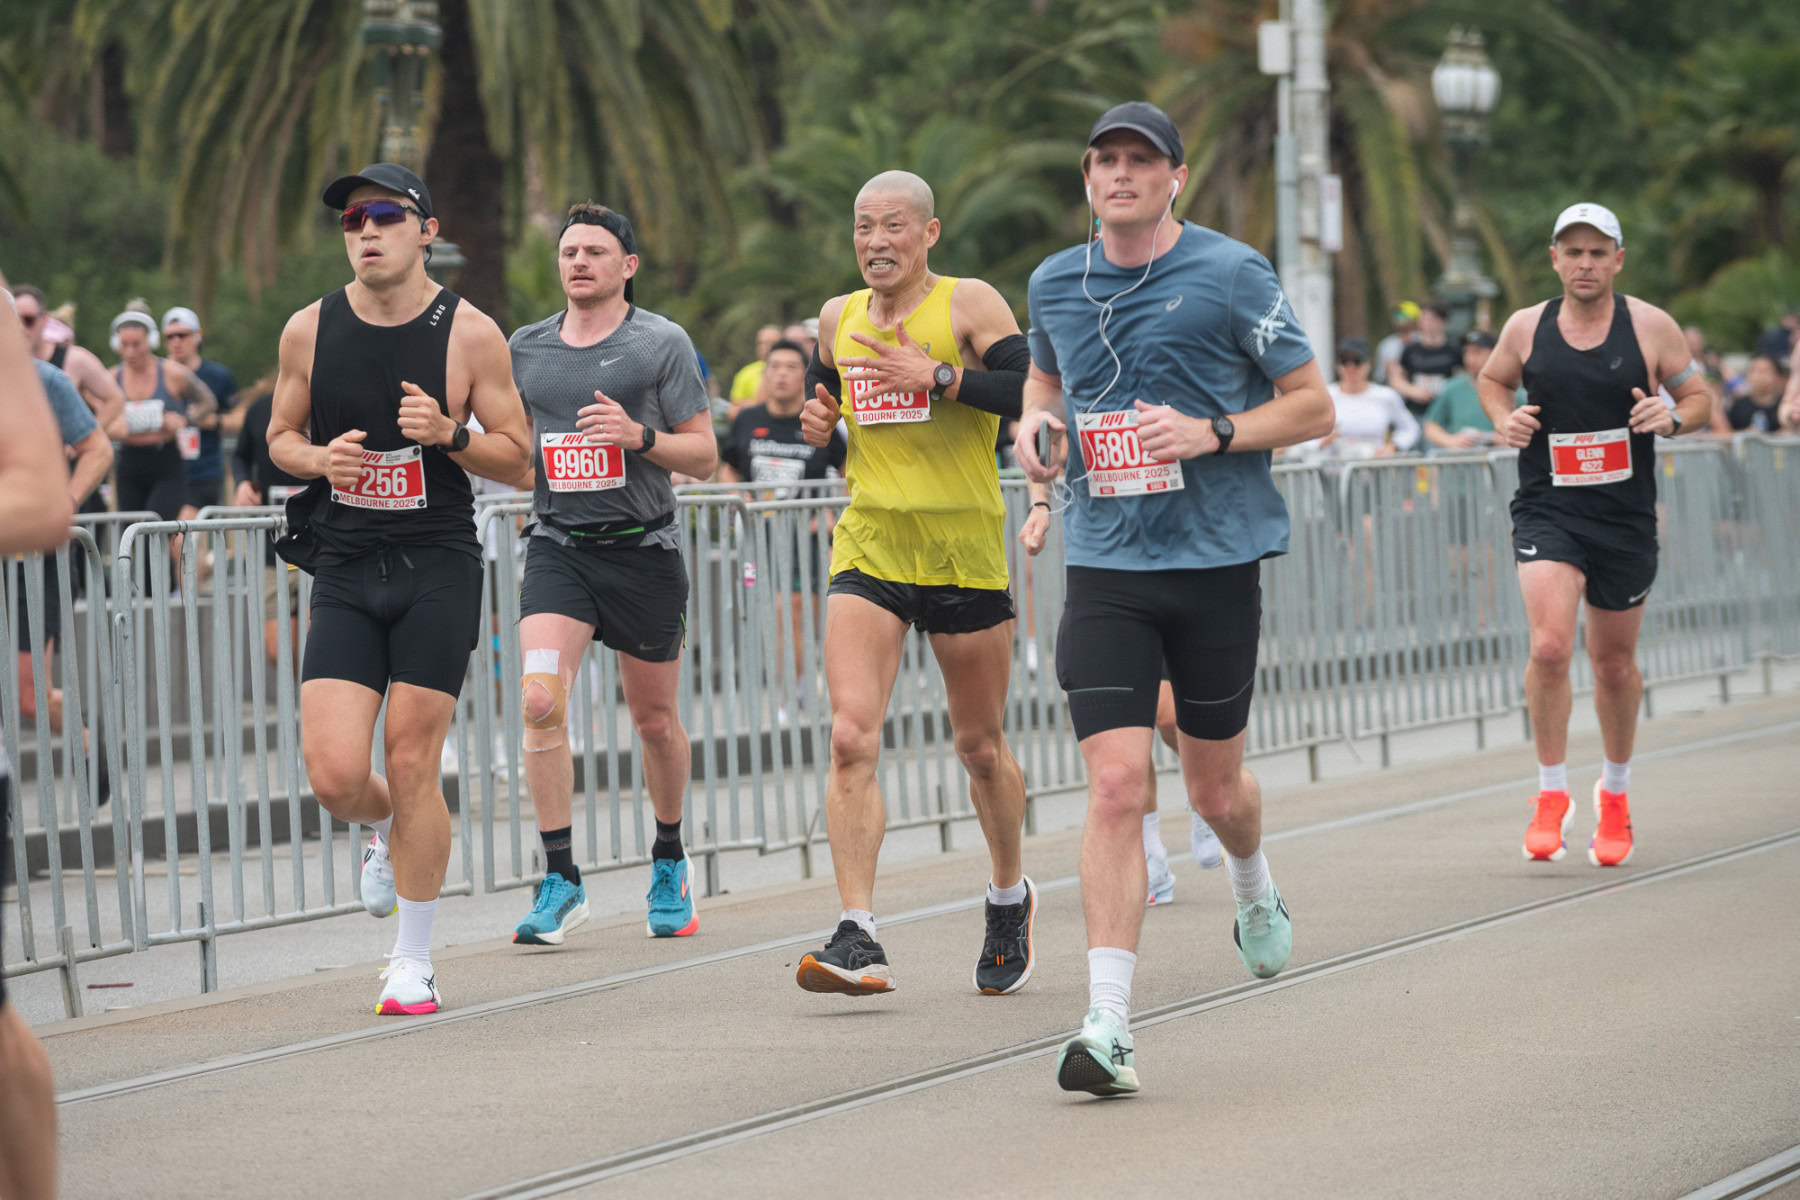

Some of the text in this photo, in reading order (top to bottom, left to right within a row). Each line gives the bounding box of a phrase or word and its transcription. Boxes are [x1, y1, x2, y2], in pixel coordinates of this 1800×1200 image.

[900, 409, 923, 420] 2025
[1575, 447, 1605, 461] GLENN
[553, 447, 609, 479] 9960
[349, 466, 408, 497] 256
[1093, 466, 1170, 483] MELBOURNE 2025
[596, 479, 617, 489] 2025
[340, 493, 390, 508] MELBOURNE
[393, 498, 416, 508] 2025
